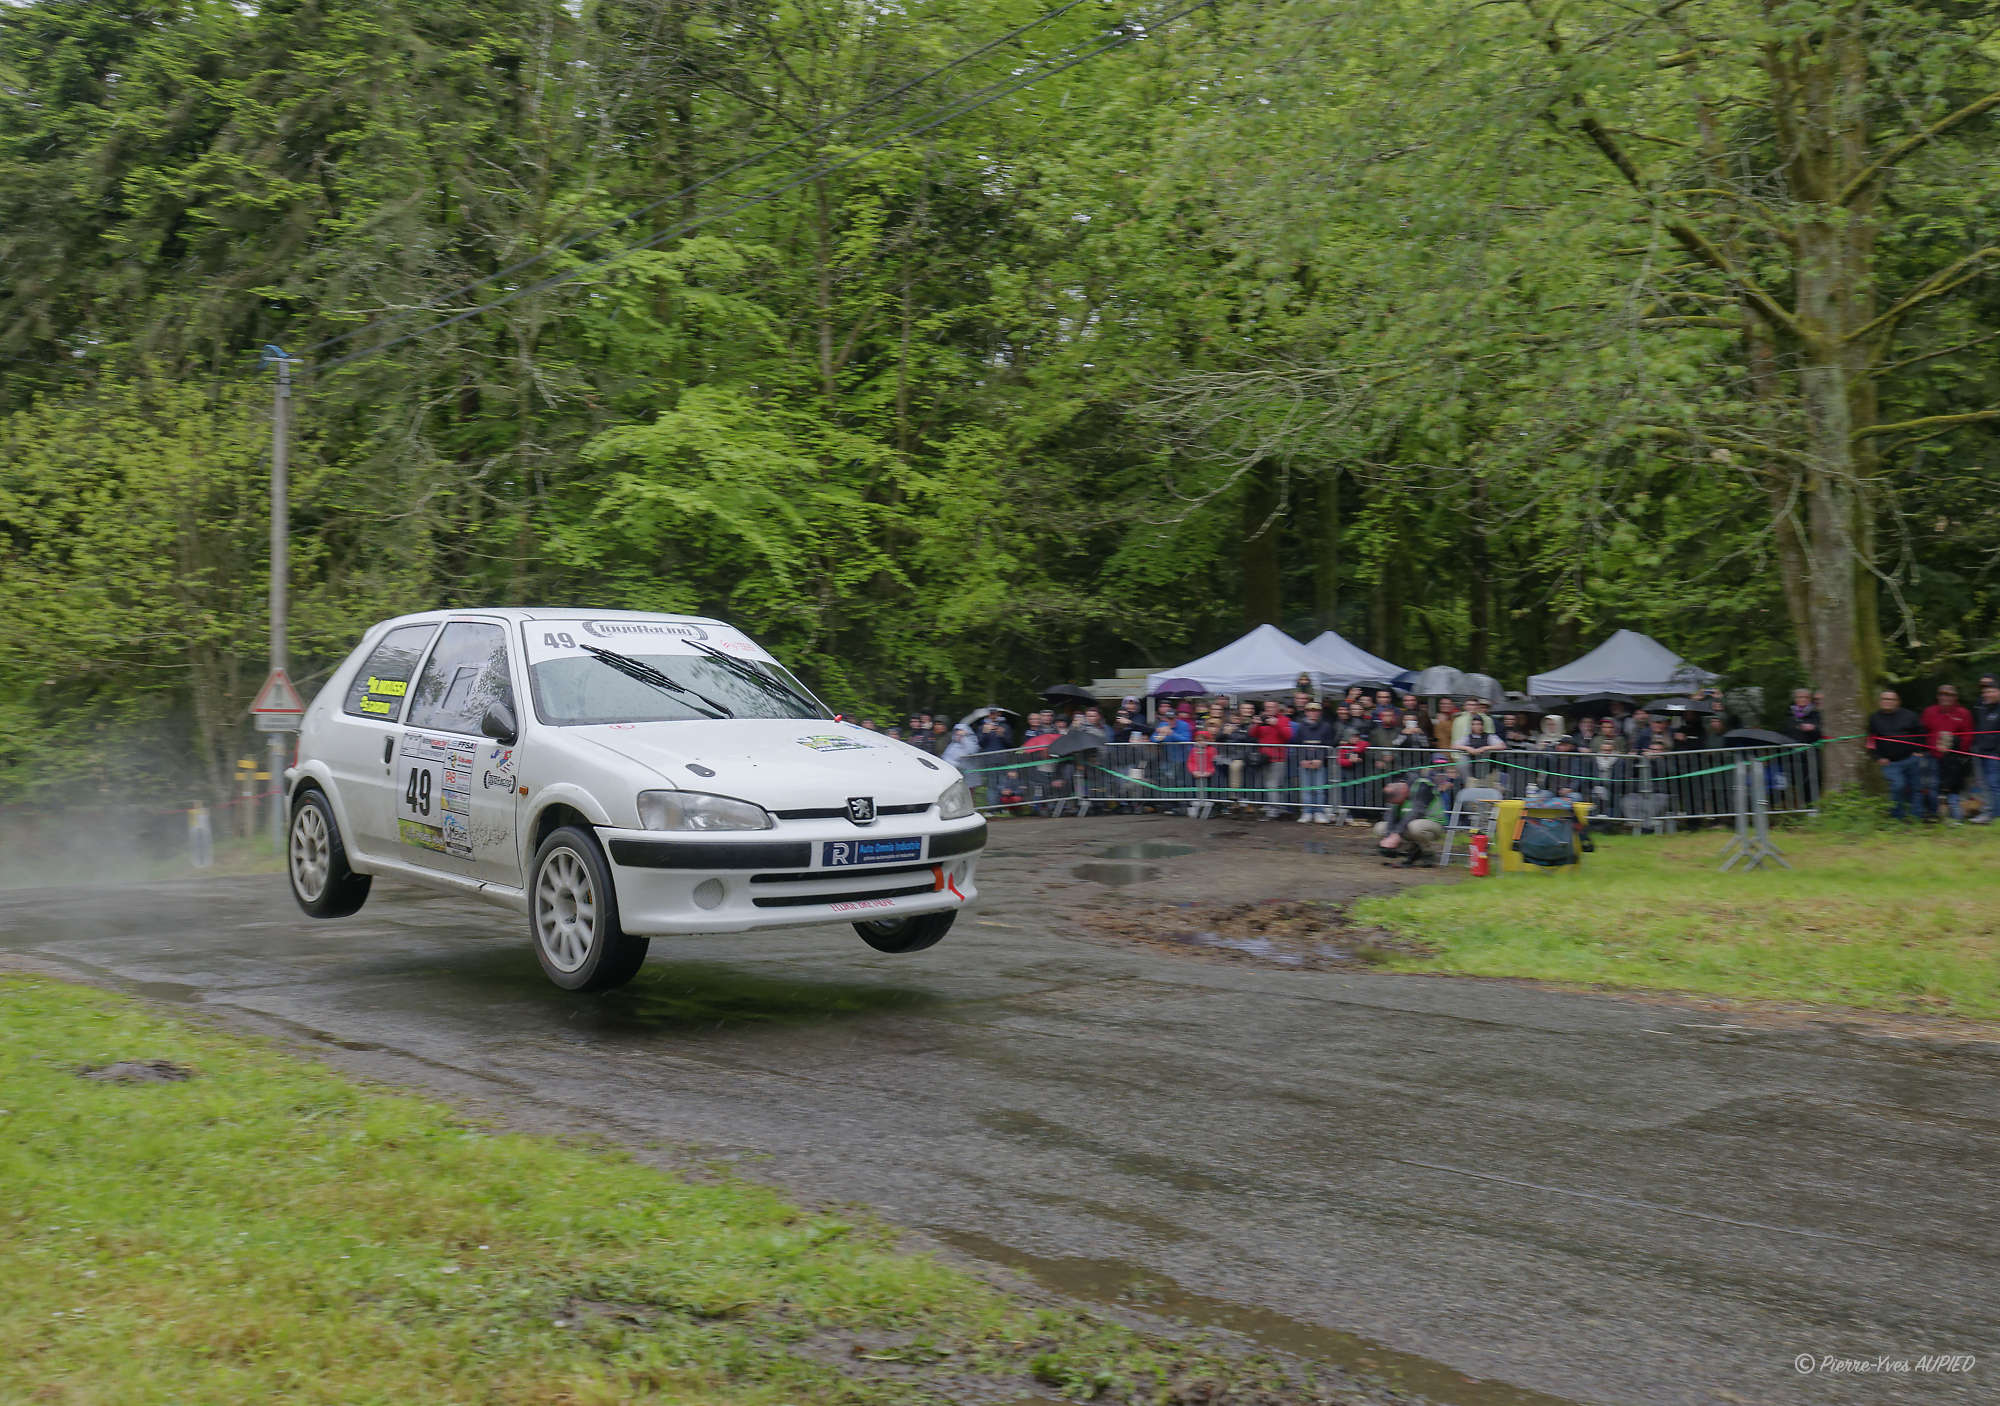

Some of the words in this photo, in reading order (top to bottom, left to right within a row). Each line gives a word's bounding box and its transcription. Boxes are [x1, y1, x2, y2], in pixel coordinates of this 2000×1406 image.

[543, 632, 577, 649] 49
[457, 740, 474, 750] FFSA
[406, 767, 431, 816] 49
